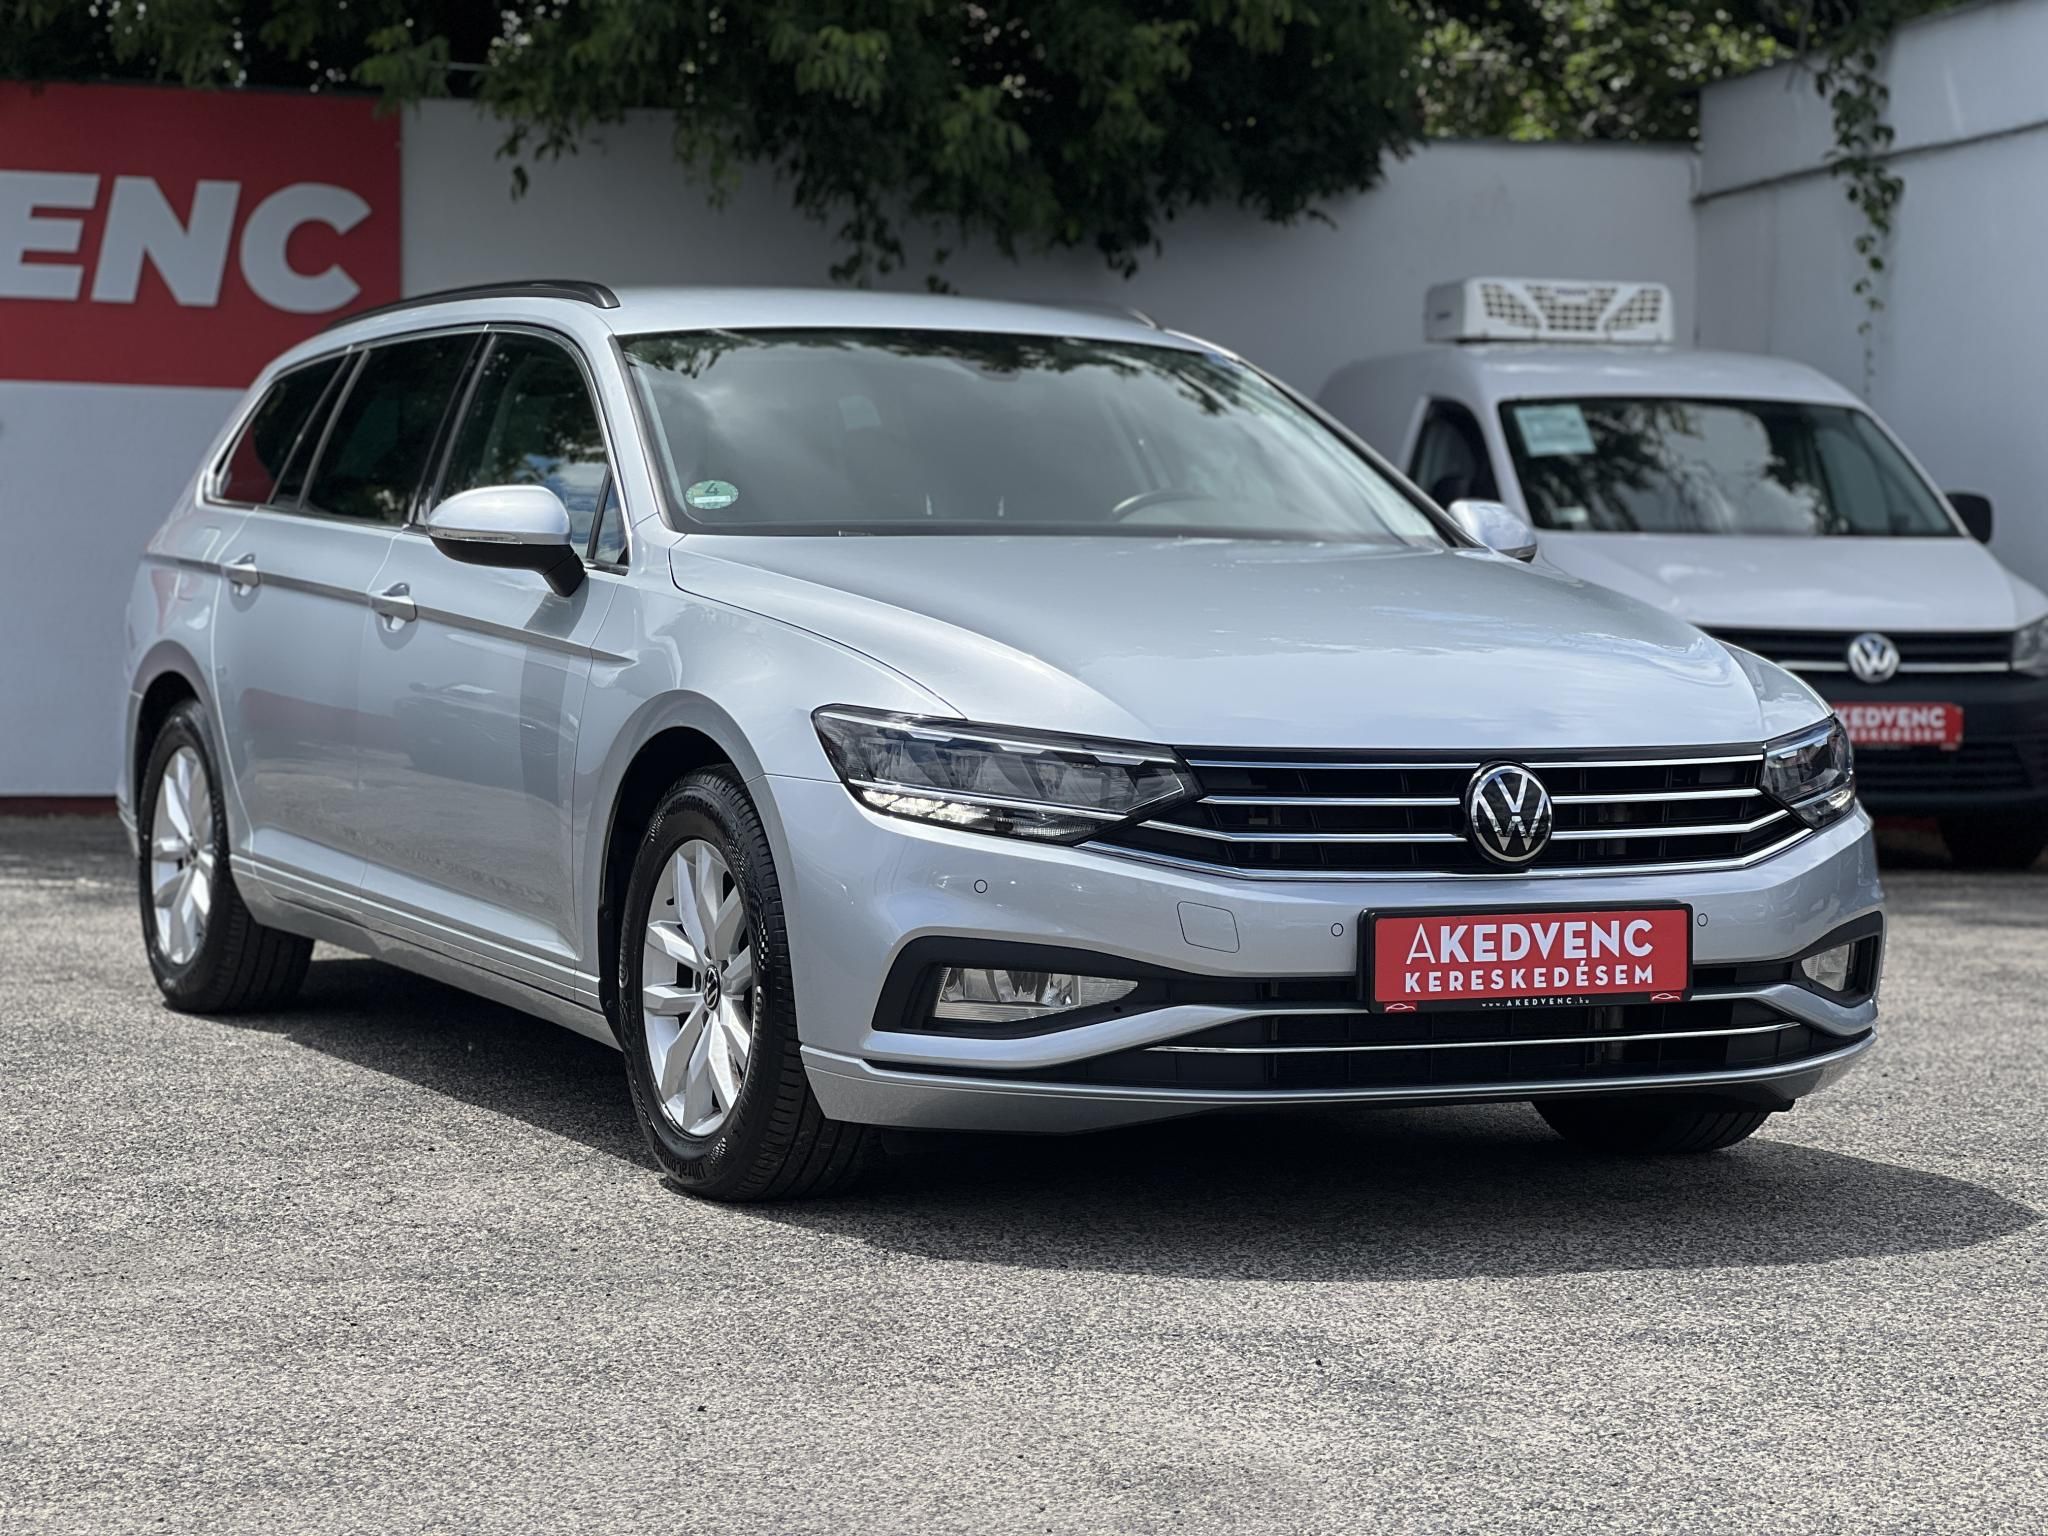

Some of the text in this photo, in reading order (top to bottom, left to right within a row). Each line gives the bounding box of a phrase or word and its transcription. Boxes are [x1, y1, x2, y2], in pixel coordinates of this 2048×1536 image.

[0, 170, 372, 314] ENC
[1406, 919, 1654, 965] AKEDVENC
[1405, 960, 1653, 993] KERESKEDÉSEM
